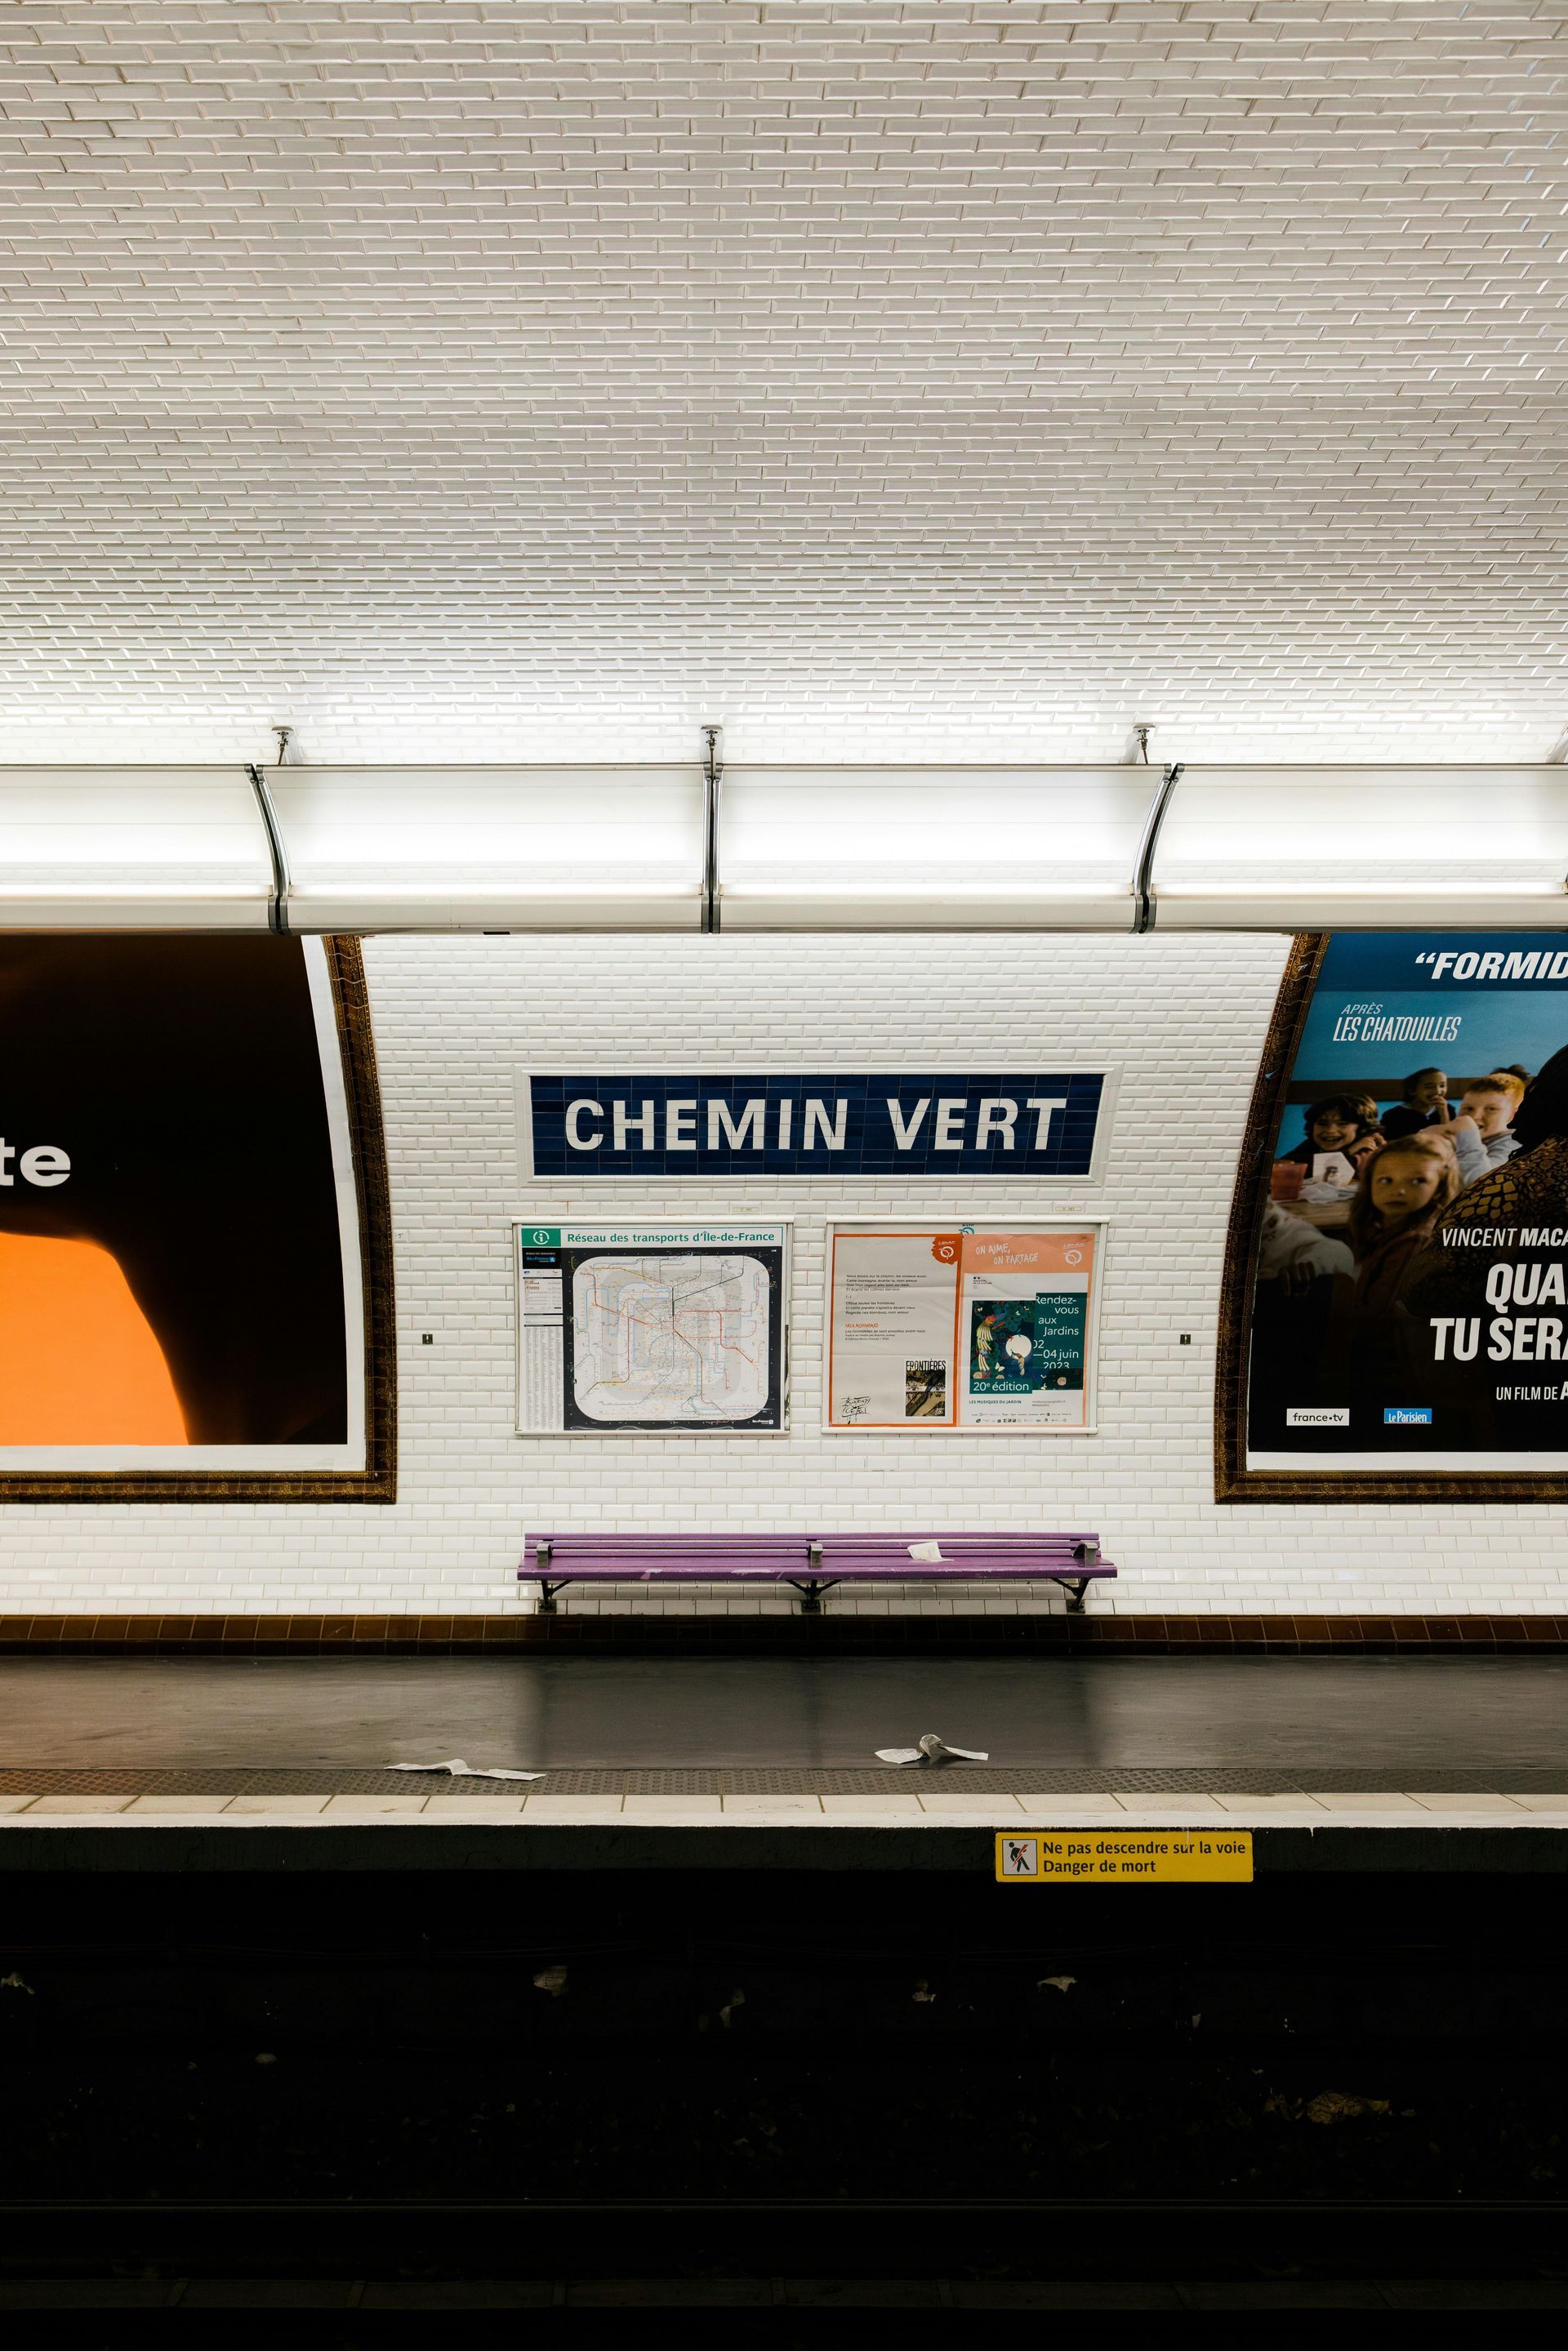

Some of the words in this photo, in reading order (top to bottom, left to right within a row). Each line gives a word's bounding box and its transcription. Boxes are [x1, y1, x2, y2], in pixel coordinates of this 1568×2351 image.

[1341, 1002, 1383, 1014] APRÈS
[1333, 1017, 1361, 1041] LES
[1361, 1016, 1462, 1041] CHATOUILLES
[564, 1098, 849, 1151] CHEMIN
[887, 1098, 1067, 1151] VERT
[568, 1231, 606, 1243] Réseau
[610, 1233, 629, 1243] des
[633, 1233, 688, 1245] transports
[1442, 1228, 1518, 1247] VINCENT
[976, 1246, 986, 1255] ON
[988, 1242, 1010, 1255] AIME,
[994, 1256, 1004, 1265] ON
[1005, 1253, 1039, 1265] PARTAGE
[1485, 1263, 1568, 1314] QUA
[1036, 1296, 1076, 1304] Rendez-
[1043, 1326, 1079, 1337] Jardins
[1429, 1317, 1481, 1361] TU
[1487, 1317, 1568, 1361] SER
[1058, 1349, 1079, 1361] juin
[906, 1358, 947, 1371] FRONTIÈRES
[992, 1381, 1029, 1391] édition
[1496, 1387, 1512, 1400] UN
[1514, 1387, 1541, 1400] FILM
[1544, 1387, 1558, 1400] DE
[1388, 1413, 1396, 1423] Le
[1396, 1411, 1427, 1423] Parisien
[1043, 1841, 1062, 1855] Ne
[1067, 1844, 1091, 1857] pas
[1095, 1841, 1169, 1855] descendre
[1173, 1844, 1195, 1855] sur
[1200, 1841, 1212, 1854] la
[1216, 1841, 1246, 1854] voie
[1044, 1860, 1095, 1876] Danger
[1099, 1860, 1116, 1872] de
[1121, 1861, 1156, 1872] mort
